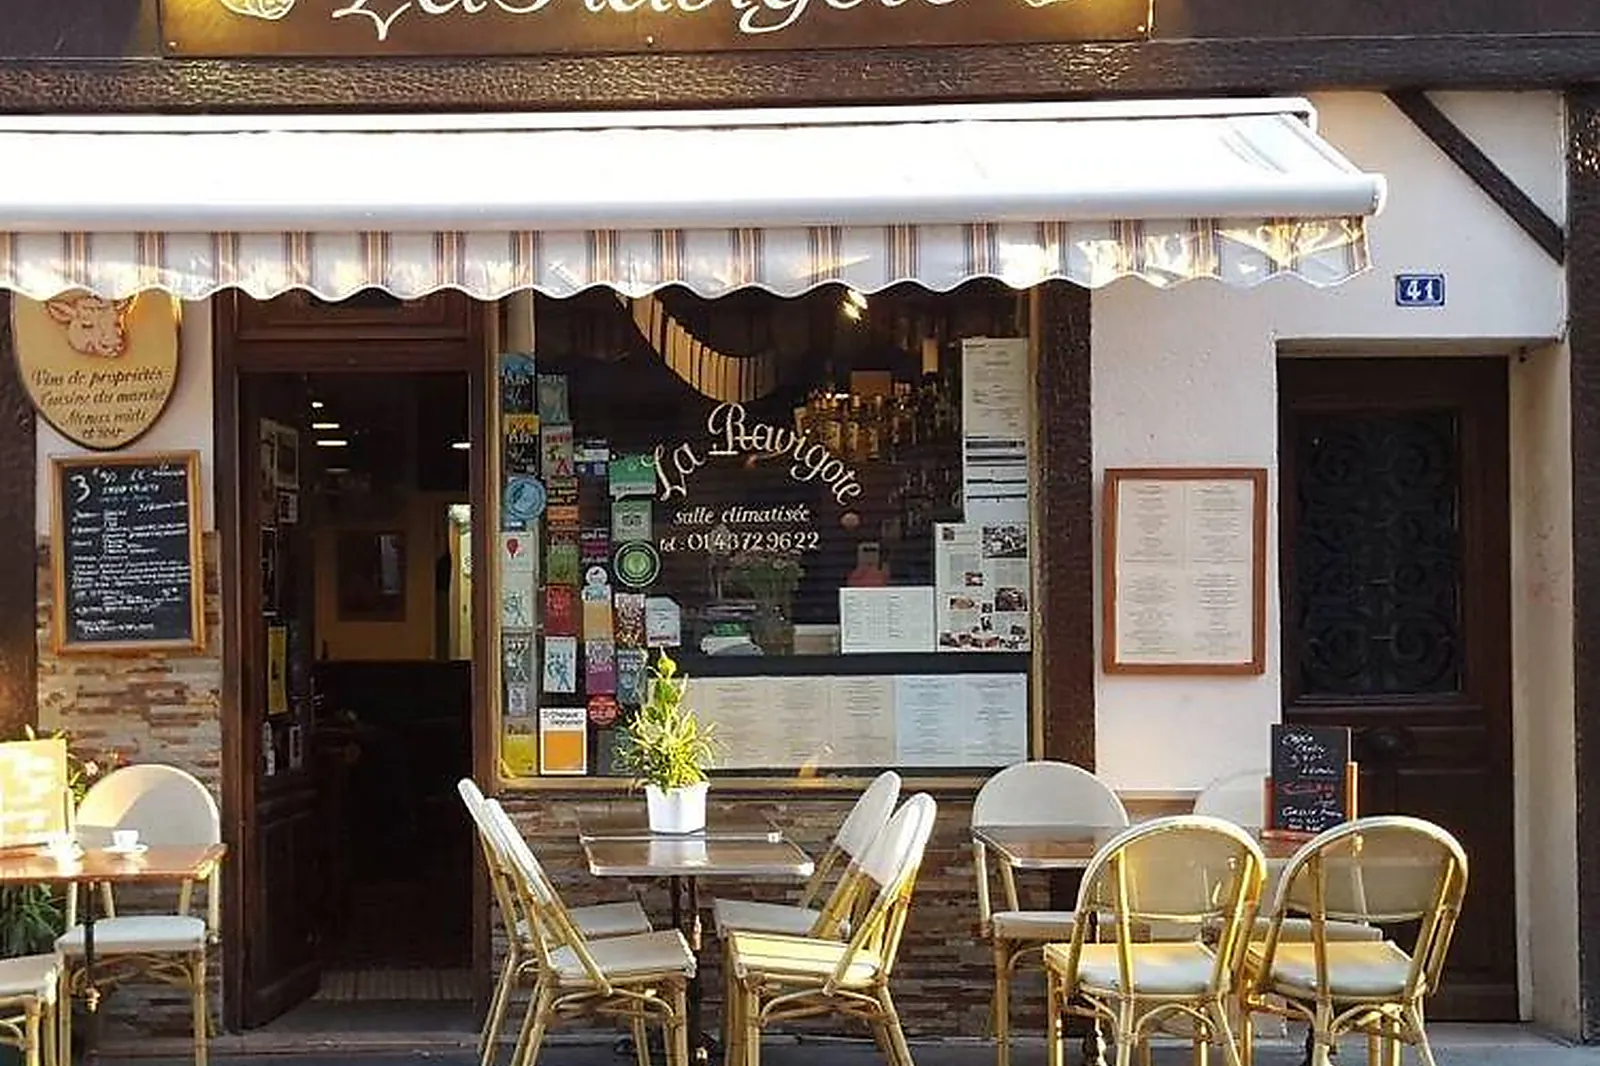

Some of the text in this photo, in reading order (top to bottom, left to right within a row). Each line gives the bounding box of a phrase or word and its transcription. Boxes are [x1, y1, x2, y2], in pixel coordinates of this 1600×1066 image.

[1407, 280, 1433, 299] 41
[68, 370, 86, 384] de
[641, 402, 863, 505] La Ravigote
[674, 503, 811, 525] salle climatisée
